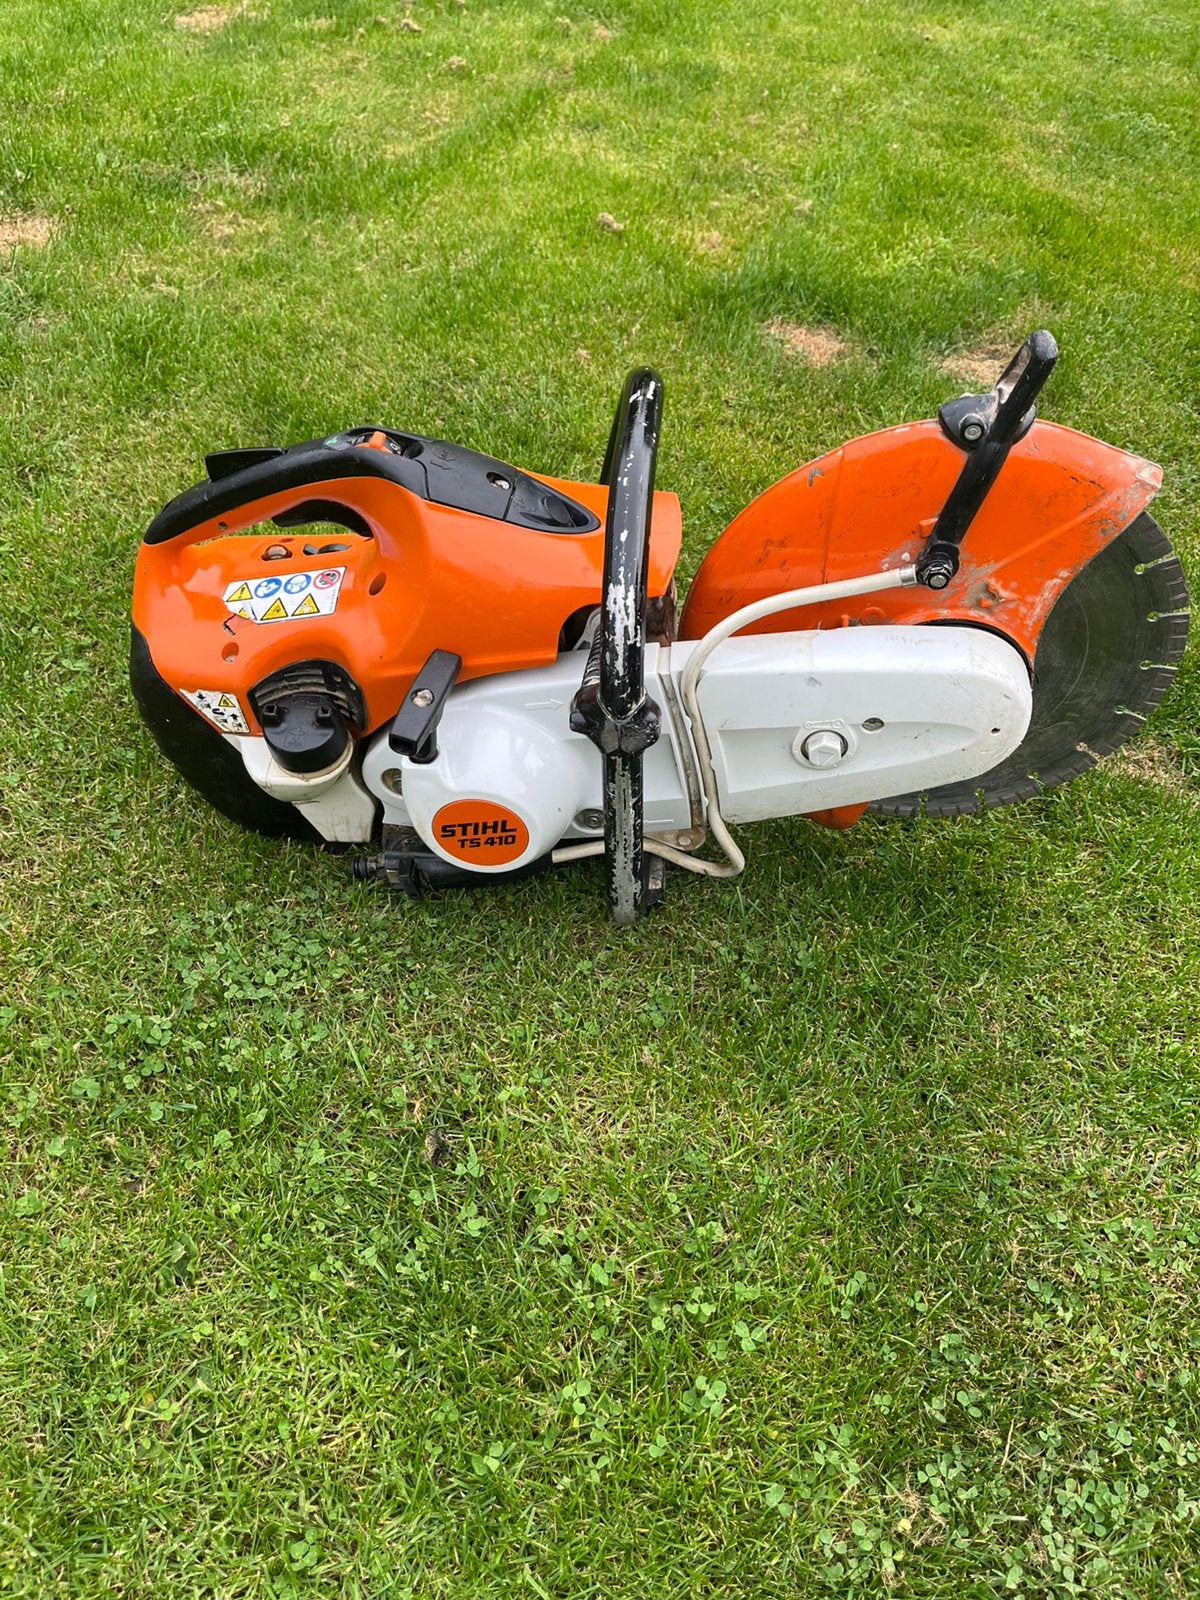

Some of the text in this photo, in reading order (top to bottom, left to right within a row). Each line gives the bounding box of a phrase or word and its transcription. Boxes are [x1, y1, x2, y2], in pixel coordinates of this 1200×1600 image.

[441, 820, 517, 838] STIHL
[457, 835, 516, 849] TS 410
